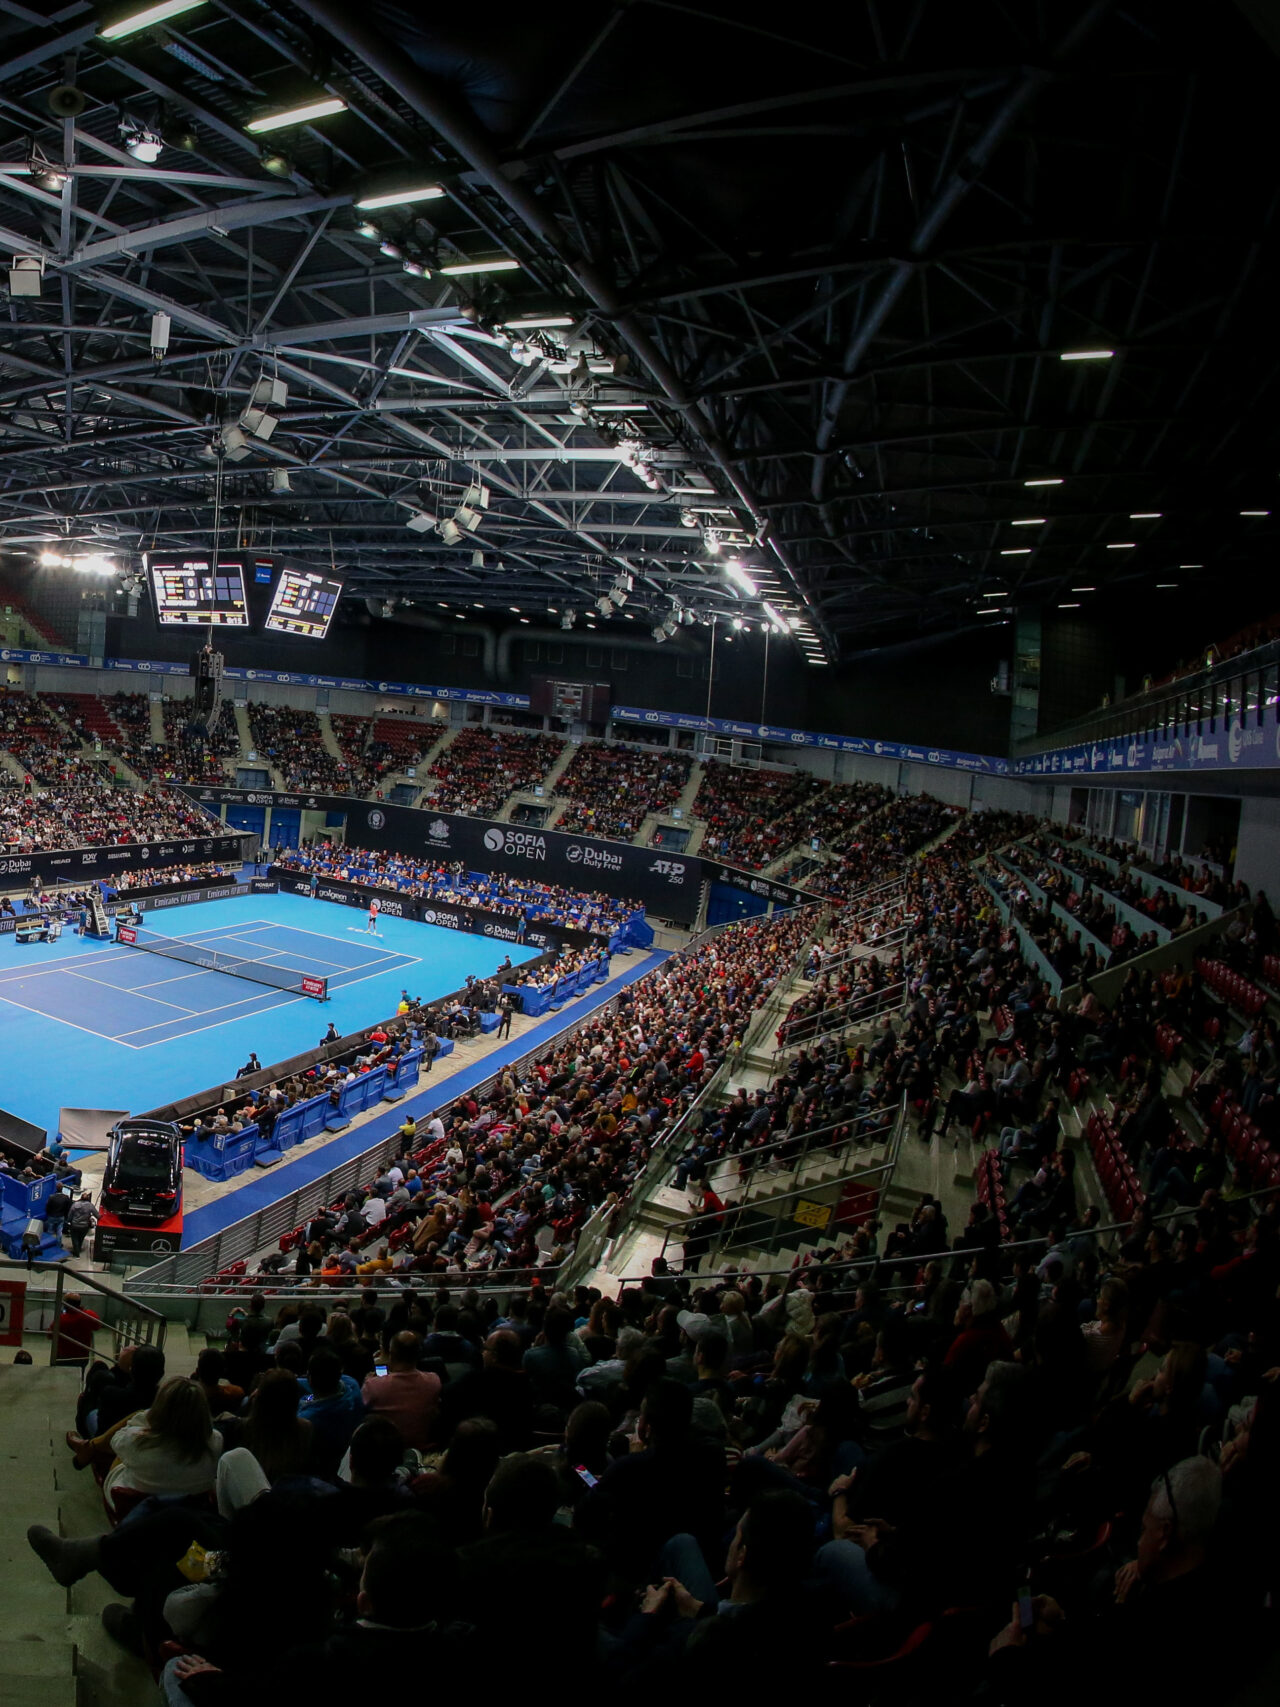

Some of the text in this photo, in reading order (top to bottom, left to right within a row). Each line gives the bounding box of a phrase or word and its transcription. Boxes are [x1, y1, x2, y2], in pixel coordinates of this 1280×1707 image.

[187, 578, 212, 587] 0 2
[189, 590, 213, 599] 0 1
[506, 831, 546, 848] SOFIA
[504, 843, 546, 861] OPEN
[584, 847, 622, 864] Dubai
[8, 860, 32, 868] Dubai
[584, 857, 622, 872] Duty Free
[649, 859, 686, 876] ATP
[668, 875, 684, 884] 250
[295, 883, 310, 891] ATP
[208, 890, 230, 898] Emirates
[154, 896, 180, 908] Emirates
[382, 900, 402, 910] SOFIA
[380, 906, 402, 916] OPEN
[436, 912, 458, 923] SOFIA
[436, 918, 458, 928] OPEN
[494, 925, 516, 936] Dubai
